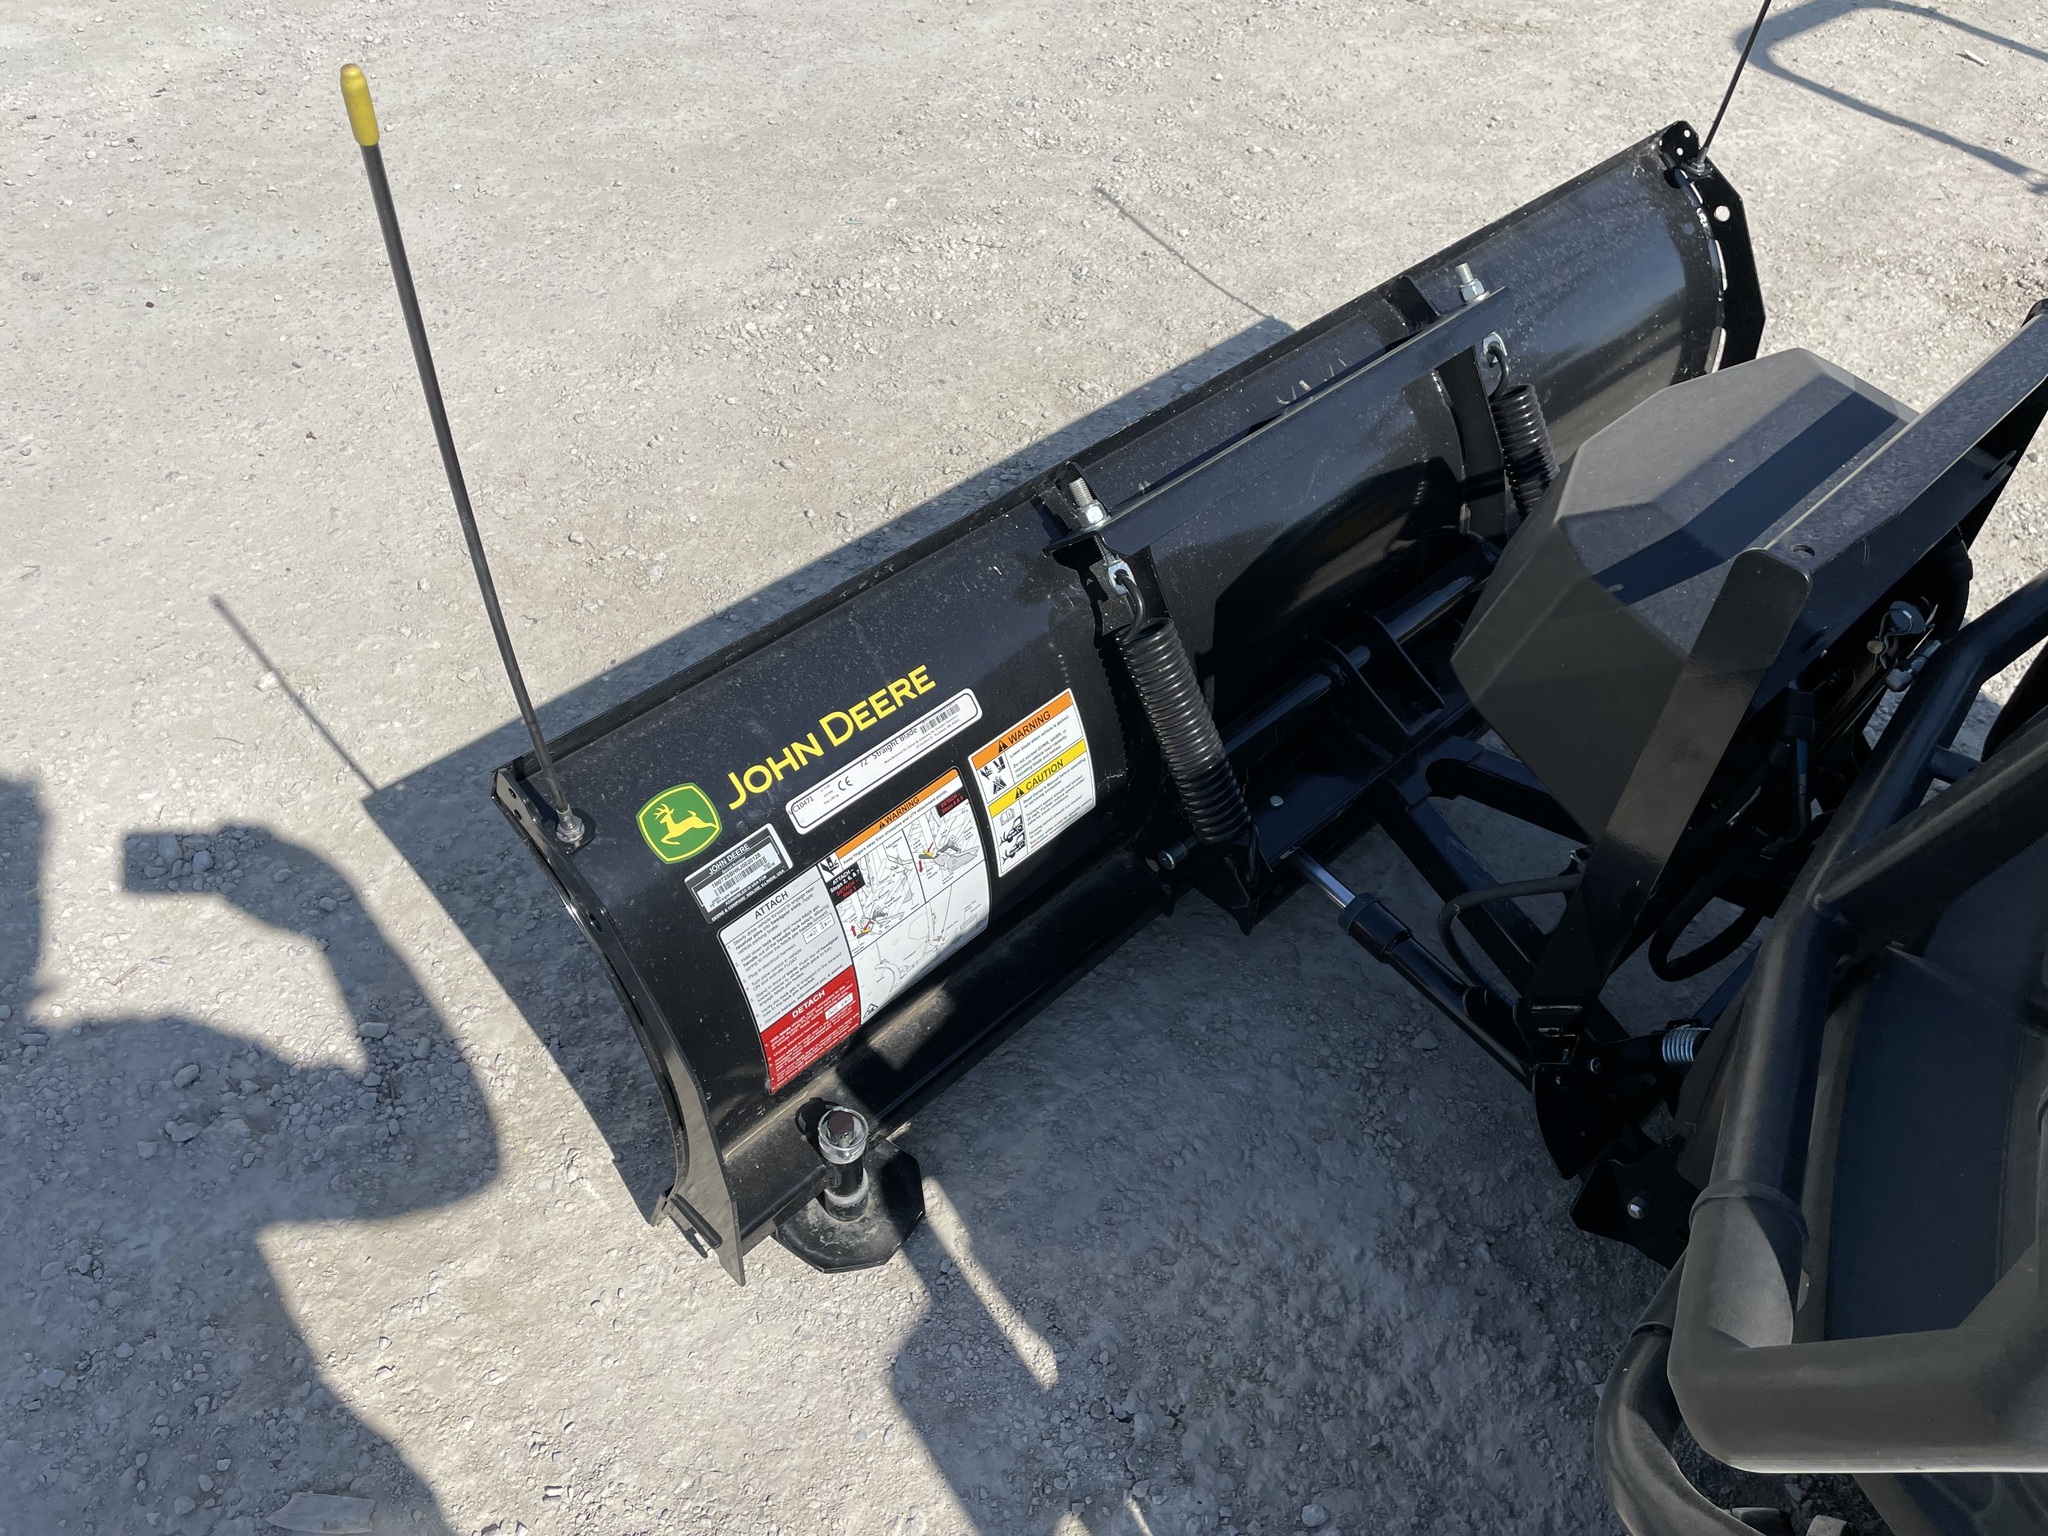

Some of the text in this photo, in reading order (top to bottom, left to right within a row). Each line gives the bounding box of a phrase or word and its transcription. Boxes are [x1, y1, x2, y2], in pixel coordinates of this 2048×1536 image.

[728, 734, 823, 809] JOHN
[820, 665, 936, 747] DEERE
[1007, 709, 1051, 745] WARNING
[1009, 748, 1020, 758] Lower
[1020, 741, 1030, 750] blade
[1030, 734, 1040, 743] when
[1040, 726, 1052, 736] vehicle
[1056, 714, 1069, 726] parked.
[871, 738, 899, 761] Straight
[898, 726, 918, 742] Blade
[1014, 758, 1032, 773] maximum
[1025, 757, 1063, 791] CAUTION
[786, 795, 814, 816] UC10471
[884, 796, 920, 825] WARNING
[843, 855, 853, 864] Keep
[852, 846, 866, 858] fingers
[866, 839, 875, 848] away
[875, 833, 884, 841] from
[901, 815, 909, 823] and
[908, 810, 916, 818] UTV
[916, 797, 935, 812] attachment
[709, 842, 749, 874] JOHN DEERE
[829, 880, 843, 894] Steps
[831, 869, 850, 885] ATTACH
[835, 880, 855, 897] DETACH
[724, 888, 747, 905] ASSEMBLED
[753, 890, 789, 919] ATTACH
[791, 989, 825, 1019] DETACH
